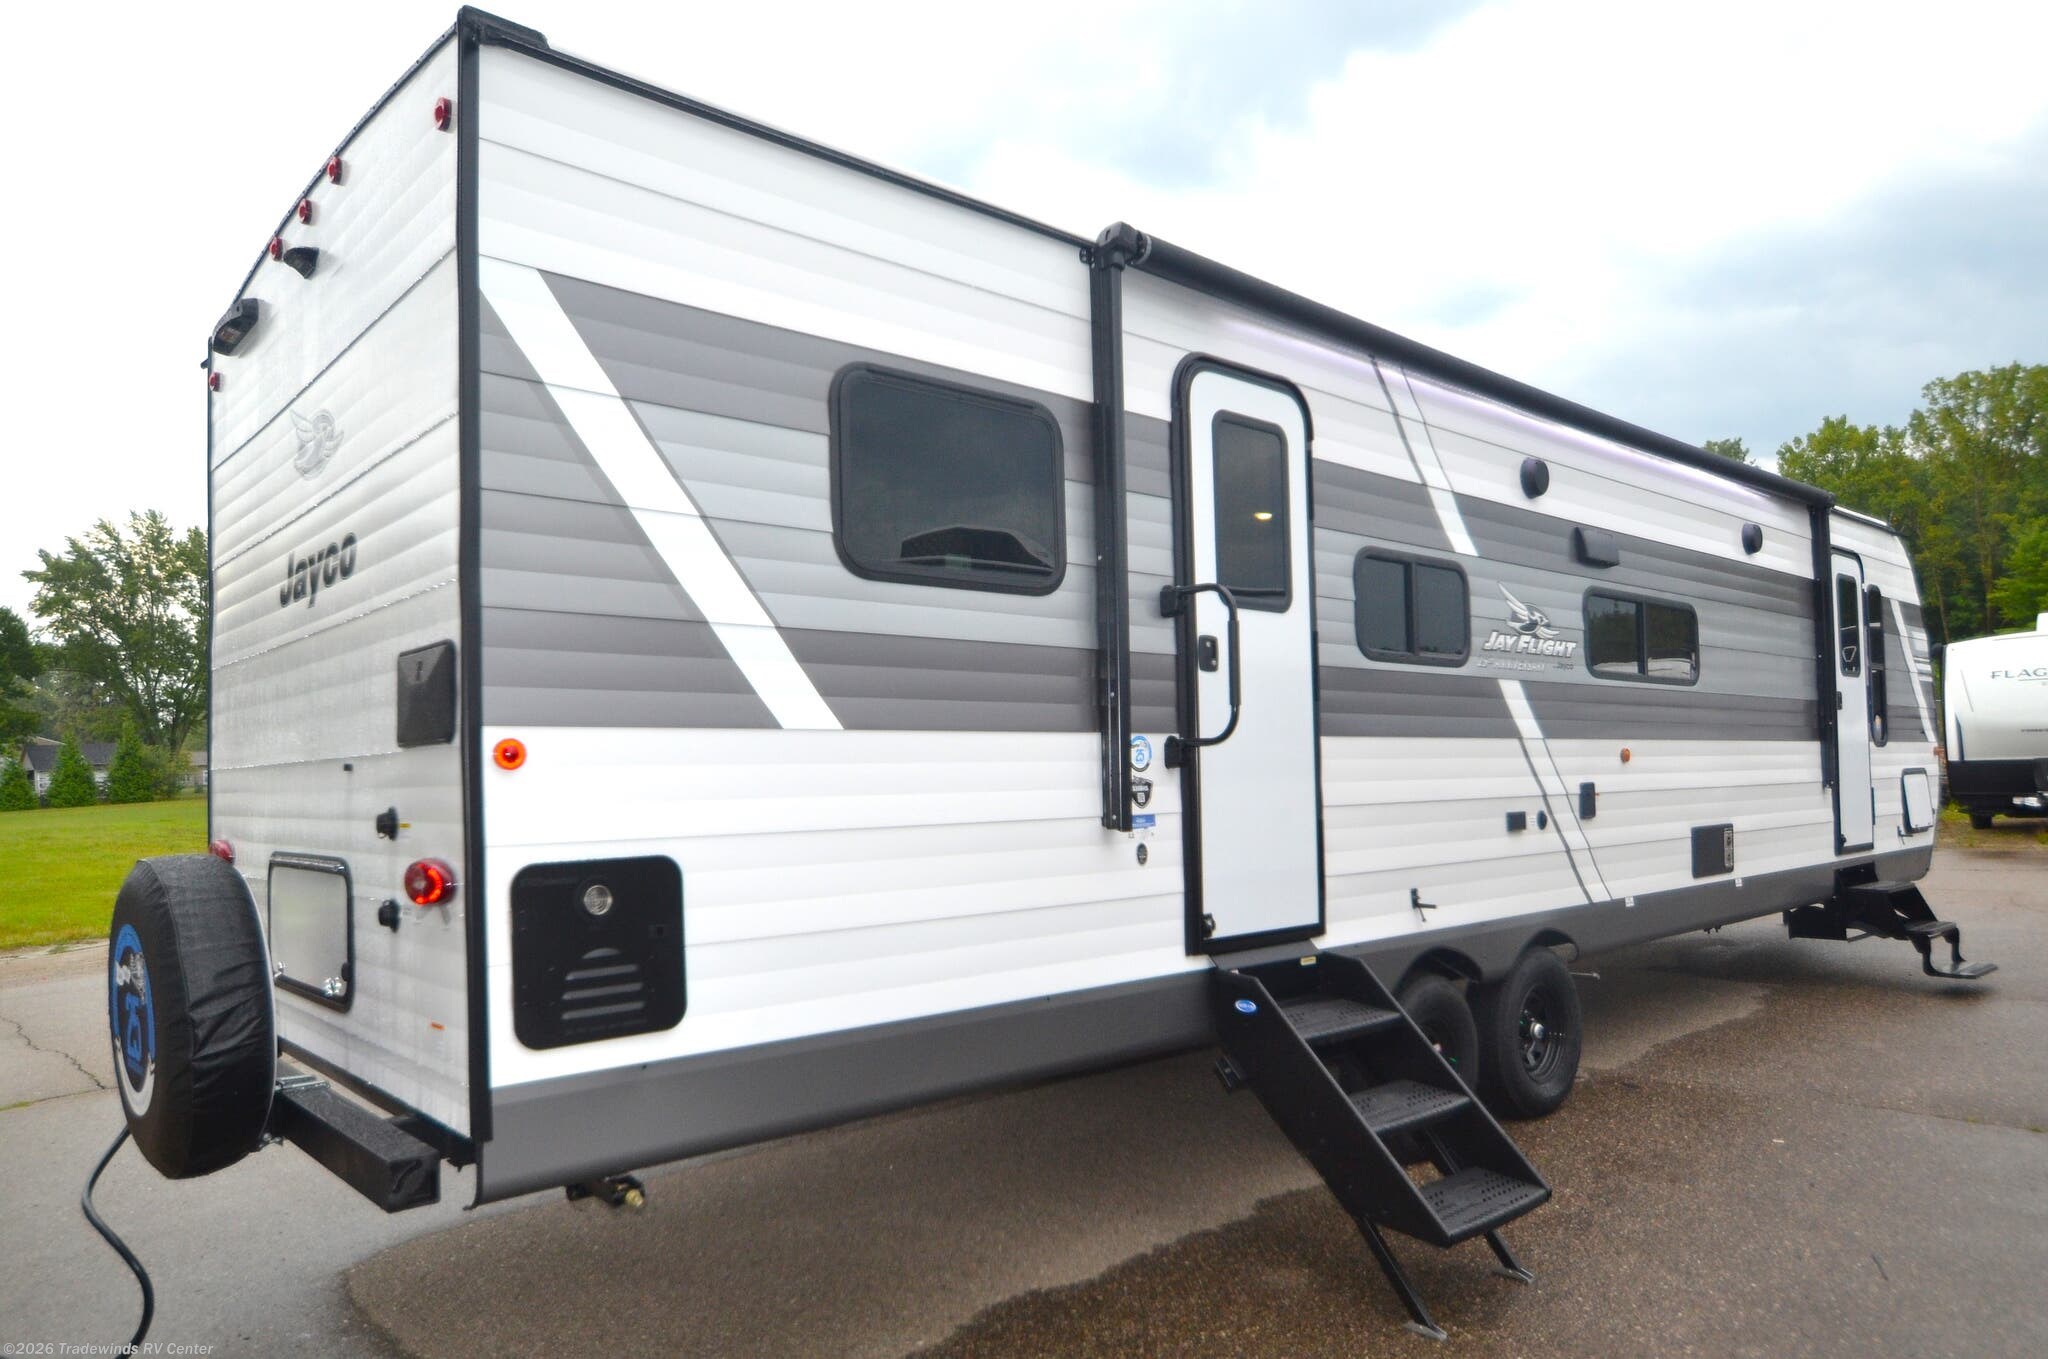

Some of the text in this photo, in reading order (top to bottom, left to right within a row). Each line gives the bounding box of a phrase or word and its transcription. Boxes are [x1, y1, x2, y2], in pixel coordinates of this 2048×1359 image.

[280, 532, 357, 608] Jayco
[1483, 630, 1576, 657] JAY FLIGHT
